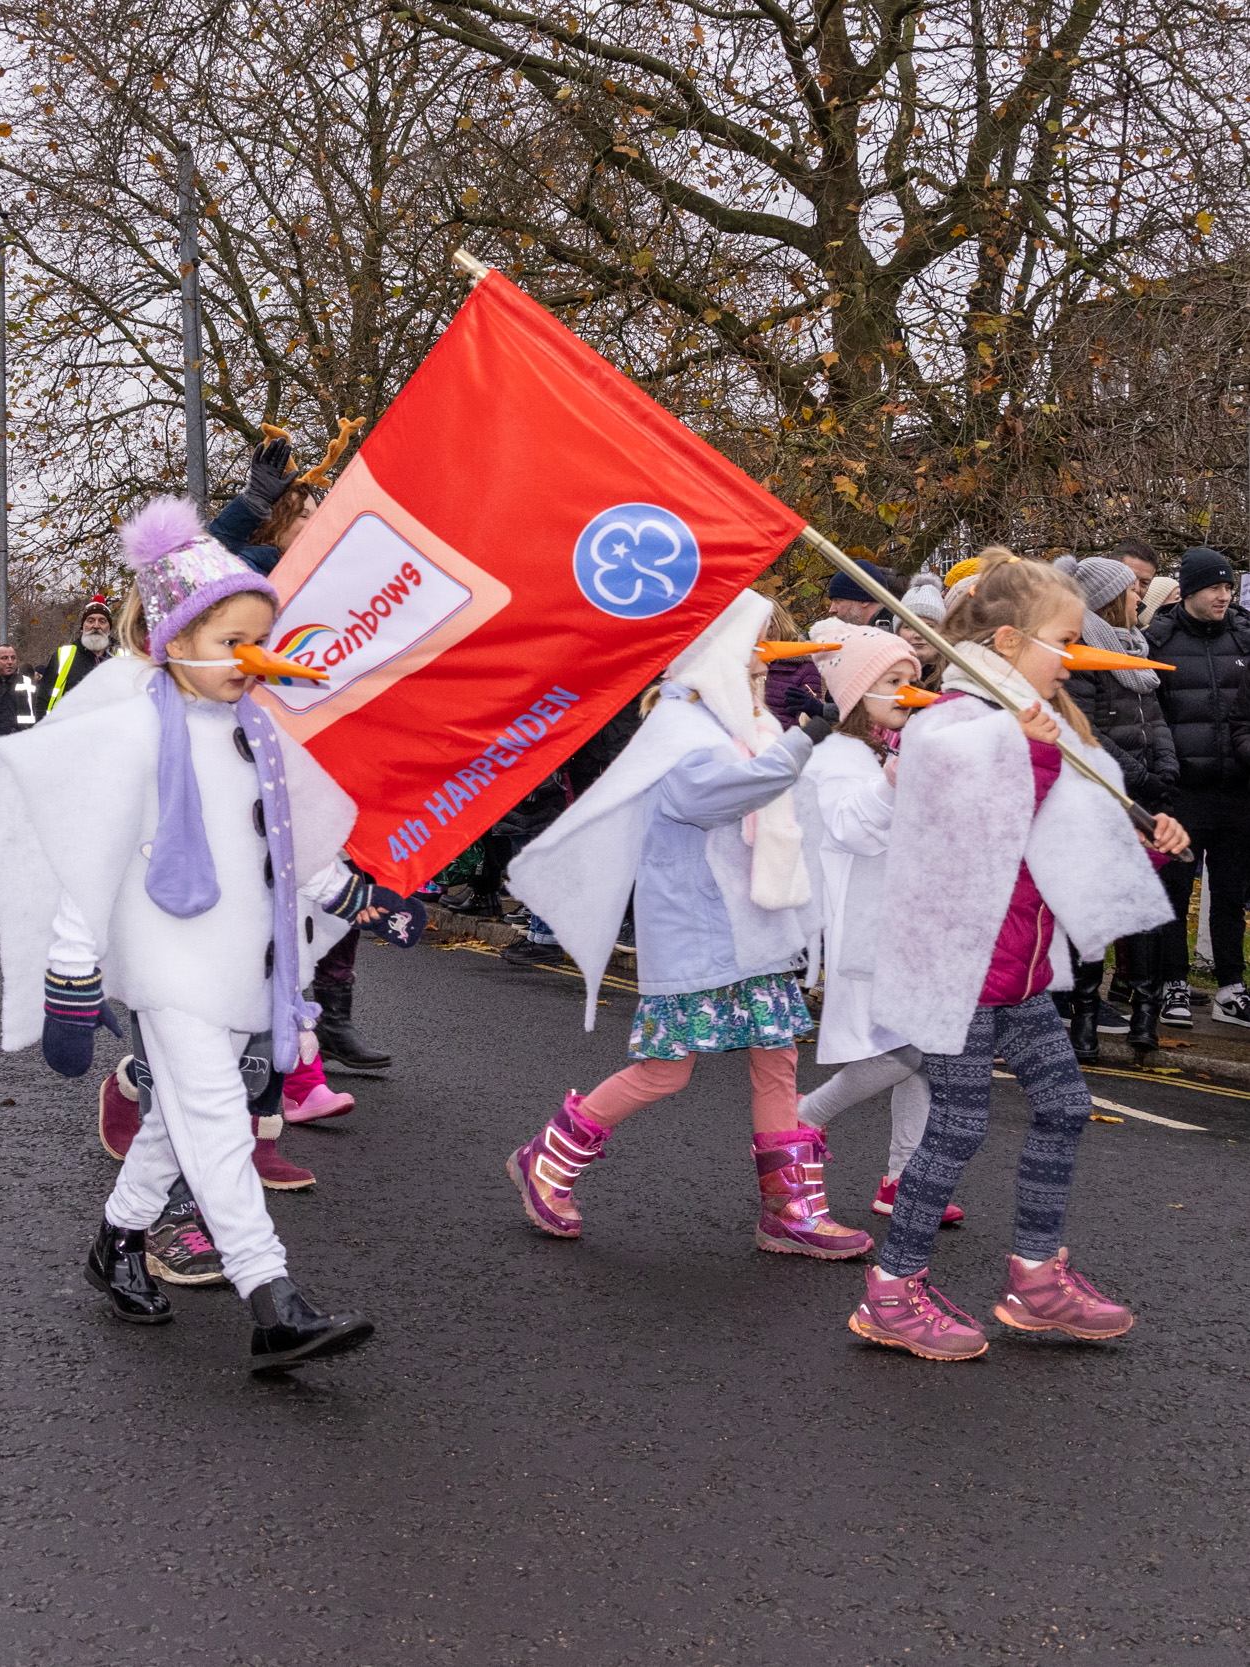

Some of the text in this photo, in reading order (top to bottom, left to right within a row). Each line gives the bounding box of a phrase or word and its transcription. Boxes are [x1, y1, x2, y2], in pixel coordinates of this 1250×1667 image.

[293, 561, 422, 686] Rainbows
[388, 685, 581, 863] 4th HARPENDEN
